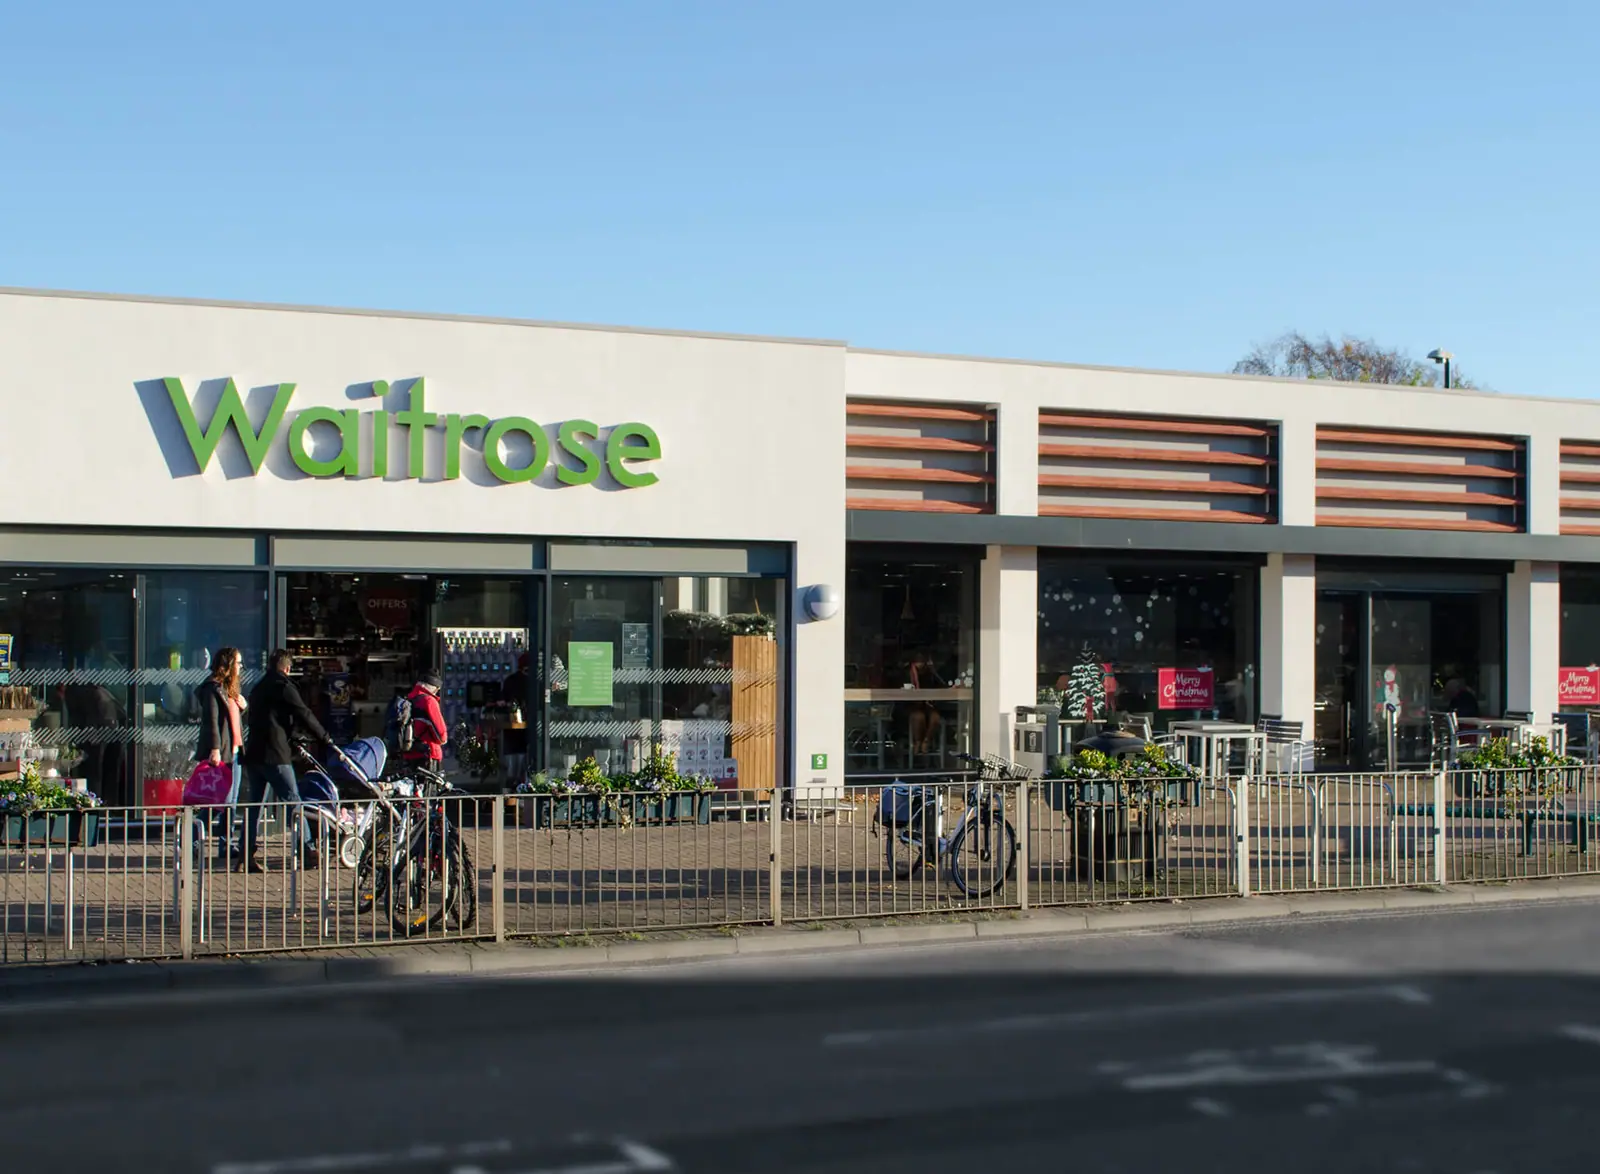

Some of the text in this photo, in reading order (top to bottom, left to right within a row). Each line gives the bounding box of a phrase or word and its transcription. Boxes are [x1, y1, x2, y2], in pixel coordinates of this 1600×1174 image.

[164, 376, 662, 488] Waitrose
[367, 599, 407, 608] OFFERS
[1176, 673, 1200, 687] Merry
[1568, 672, 1589, 685] Merry
[1164, 682, 1208, 697] Christmas
[1560, 681, 1596, 694] Christmas
